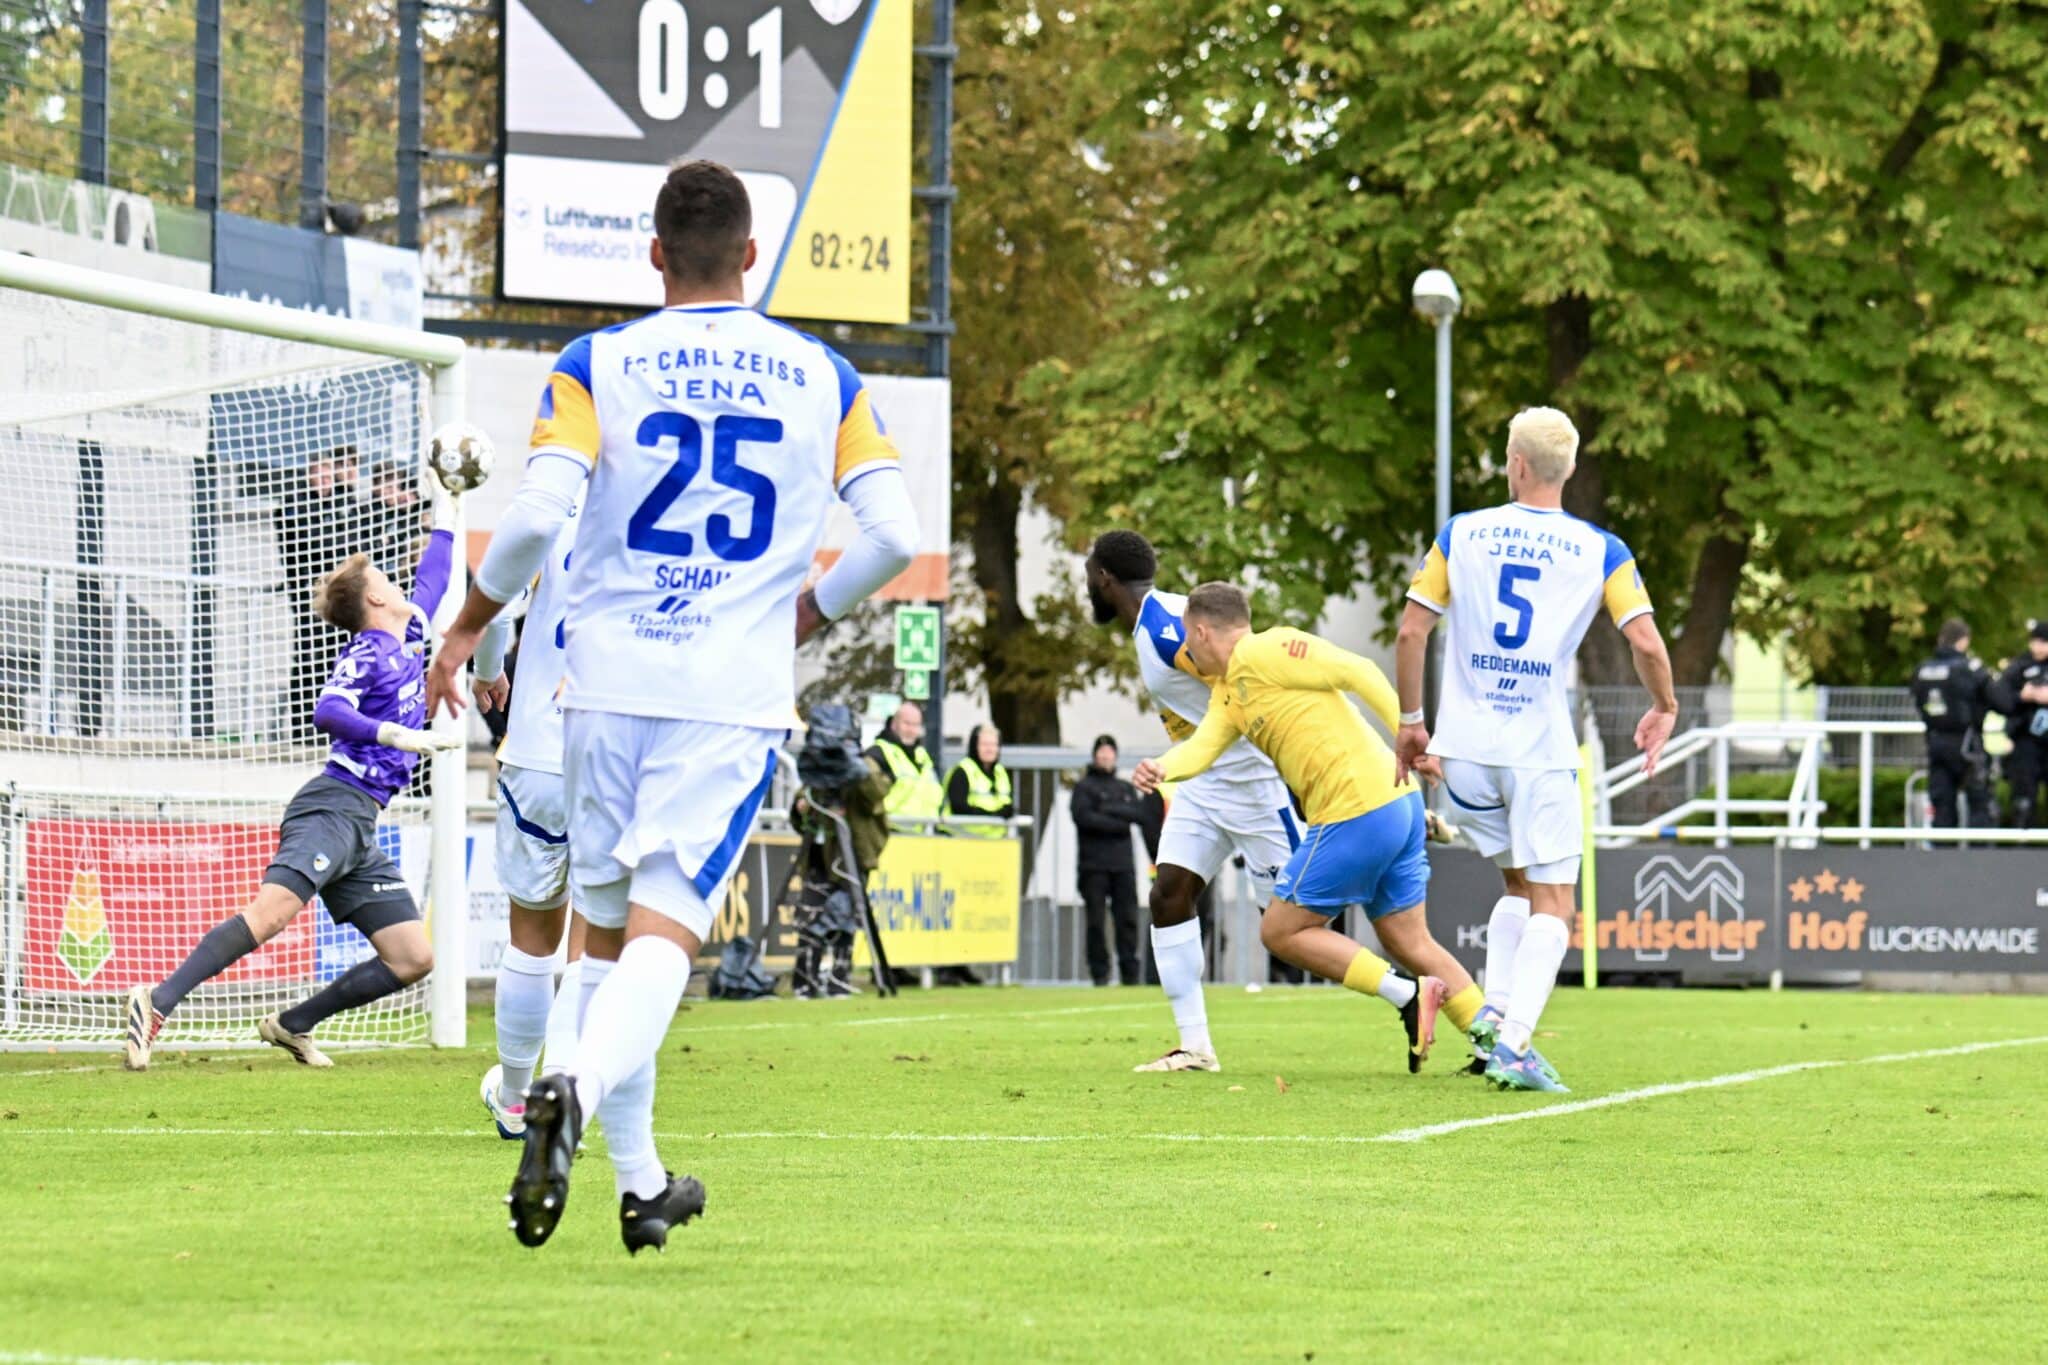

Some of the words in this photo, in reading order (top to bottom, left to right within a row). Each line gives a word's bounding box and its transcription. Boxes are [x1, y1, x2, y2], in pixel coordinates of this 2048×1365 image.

[638, 0, 782, 128] 0:1
[544, 205, 632, 231] Lufthansa
[811, 232, 889, 272] 82:24
[658, 348, 723, 370] CARL
[733, 350, 806, 387] ZEISS
[658, 379, 766, 406] JENA
[627, 411, 783, 562] 25
[1469, 529, 1487, 541] FC
[1493, 527, 1529, 539] CARL
[1537, 533, 1581, 556] ZEISS
[1488, 543, 1554, 565] JENA
[1493, 563, 1541, 650] 5
[1565, 910, 1766, 950] ärkischer
[1788, 911, 1869, 951] Hof
[1868, 926, 2039, 954] LUCKENWALDE
